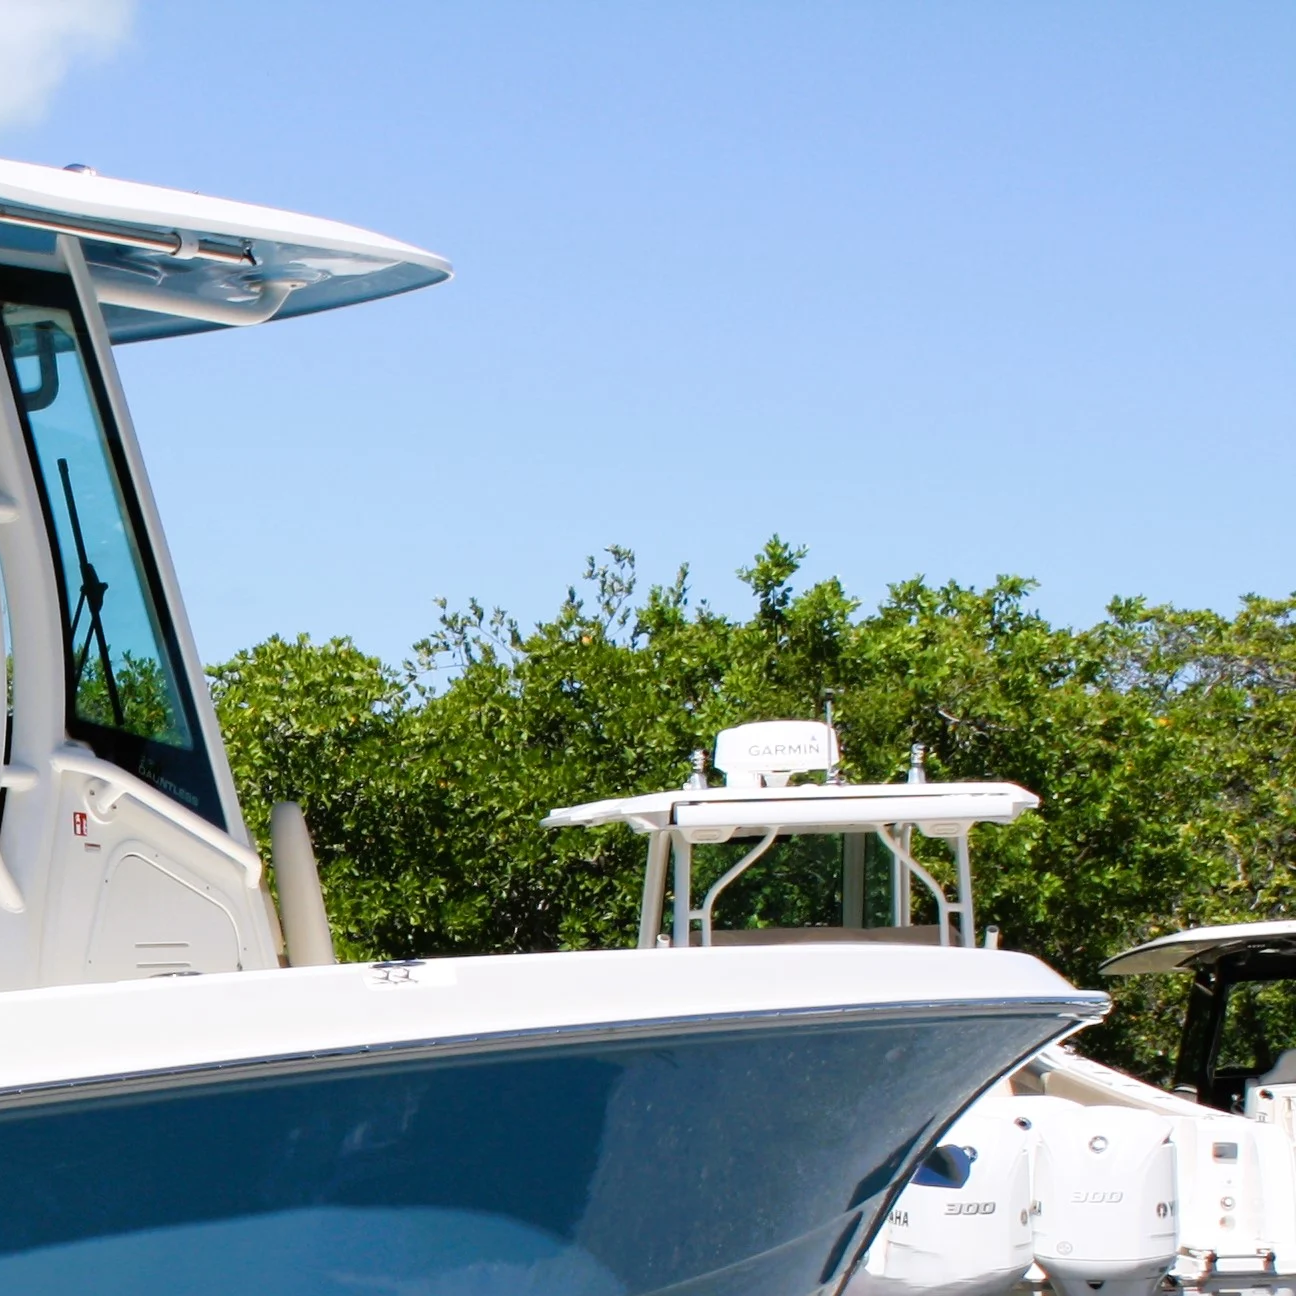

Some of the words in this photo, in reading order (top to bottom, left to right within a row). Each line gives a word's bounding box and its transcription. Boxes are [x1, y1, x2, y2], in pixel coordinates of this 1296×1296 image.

[747, 743, 820, 757] GARMIN
[1070, 1191, 1124, 1204] 300
[944, 1202, 996, 1216] 300
